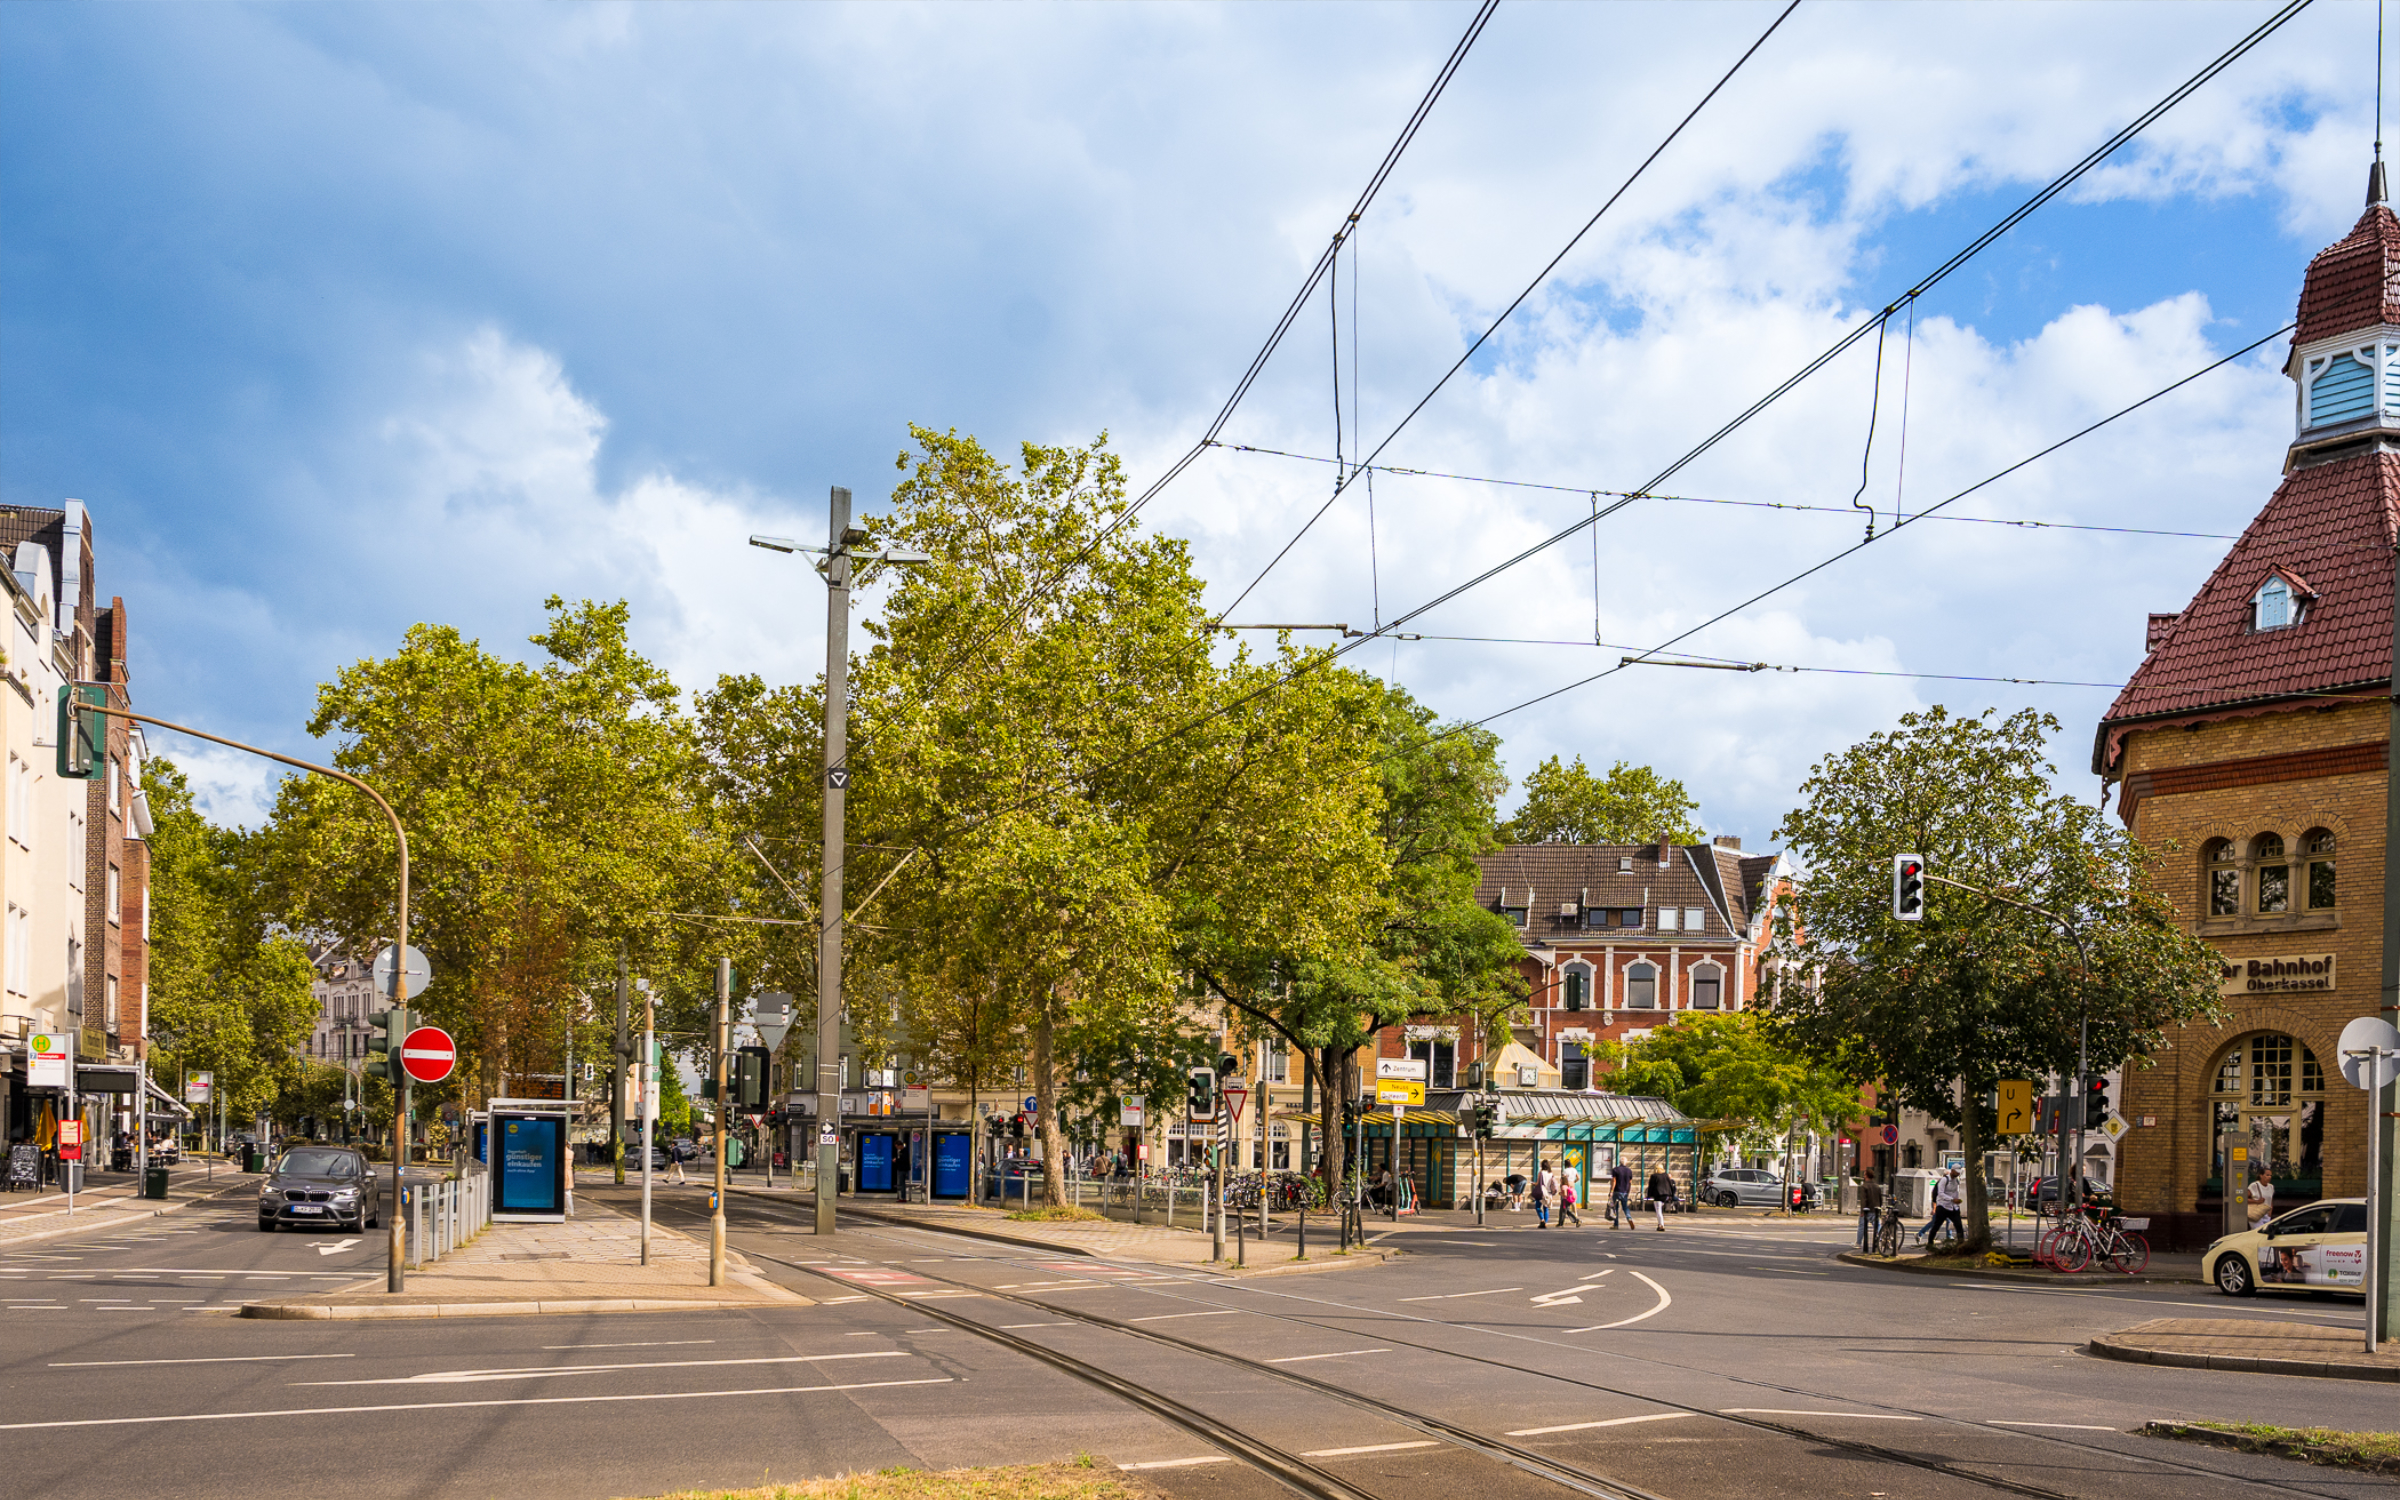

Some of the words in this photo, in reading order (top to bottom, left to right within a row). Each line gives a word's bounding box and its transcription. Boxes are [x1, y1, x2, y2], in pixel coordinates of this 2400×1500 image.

[2247, 955, 2332, 977] Bahnhof
[2247, 976, 2330, 991] Oberkassel
[1393, 1065, 1416, 1073] Zentrum
[2006, 1088, 2015, 1100] U
[506, 1153, 542, 1161] günstiger
[507, 1160, 542, 1168] einkaufen
